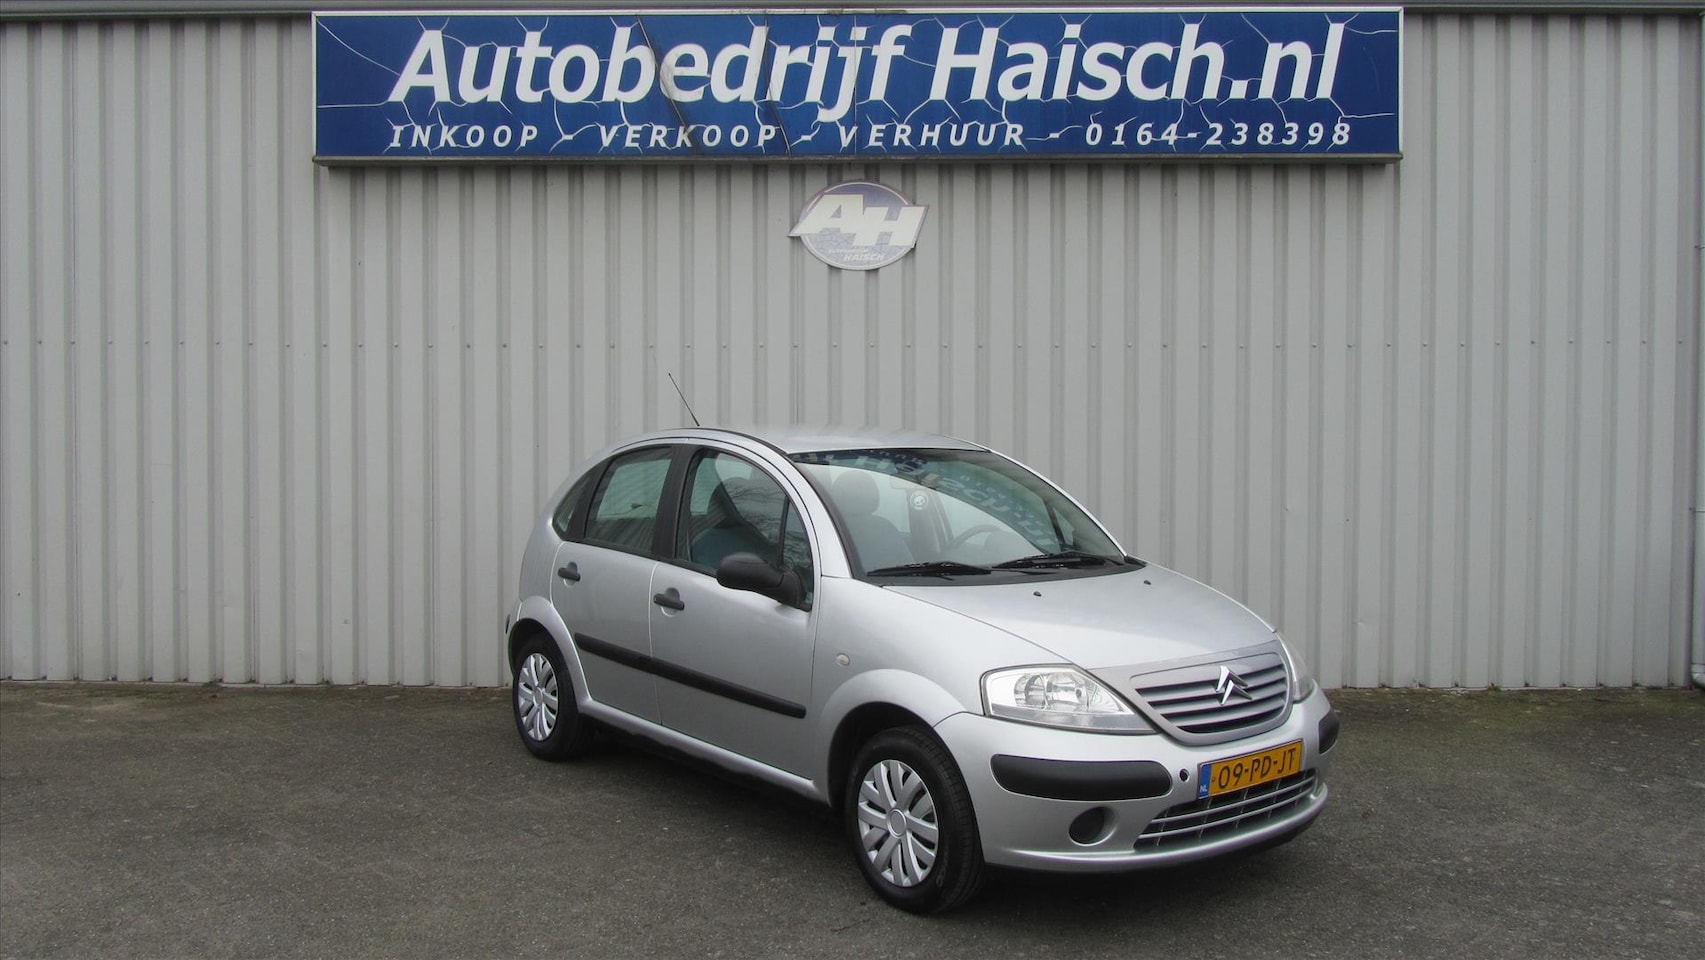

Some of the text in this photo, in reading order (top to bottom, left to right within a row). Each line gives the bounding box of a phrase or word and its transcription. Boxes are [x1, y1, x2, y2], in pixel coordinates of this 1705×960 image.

[388, 22, 1346, 122] Autobedrijf Haisch.nl
[389, 125, 539, 148] INKOOP
[599, 124, 778, 148] VERKOOP
[839, 123, 1025, 147] VERHUUR
[1085, 122, 1351, 147] 0164-238398
[788, 193, 926, 248] AH
[1199, 784, 1208, 793] NL
[1218, 748, 1296, 789] 09-PD-JT
